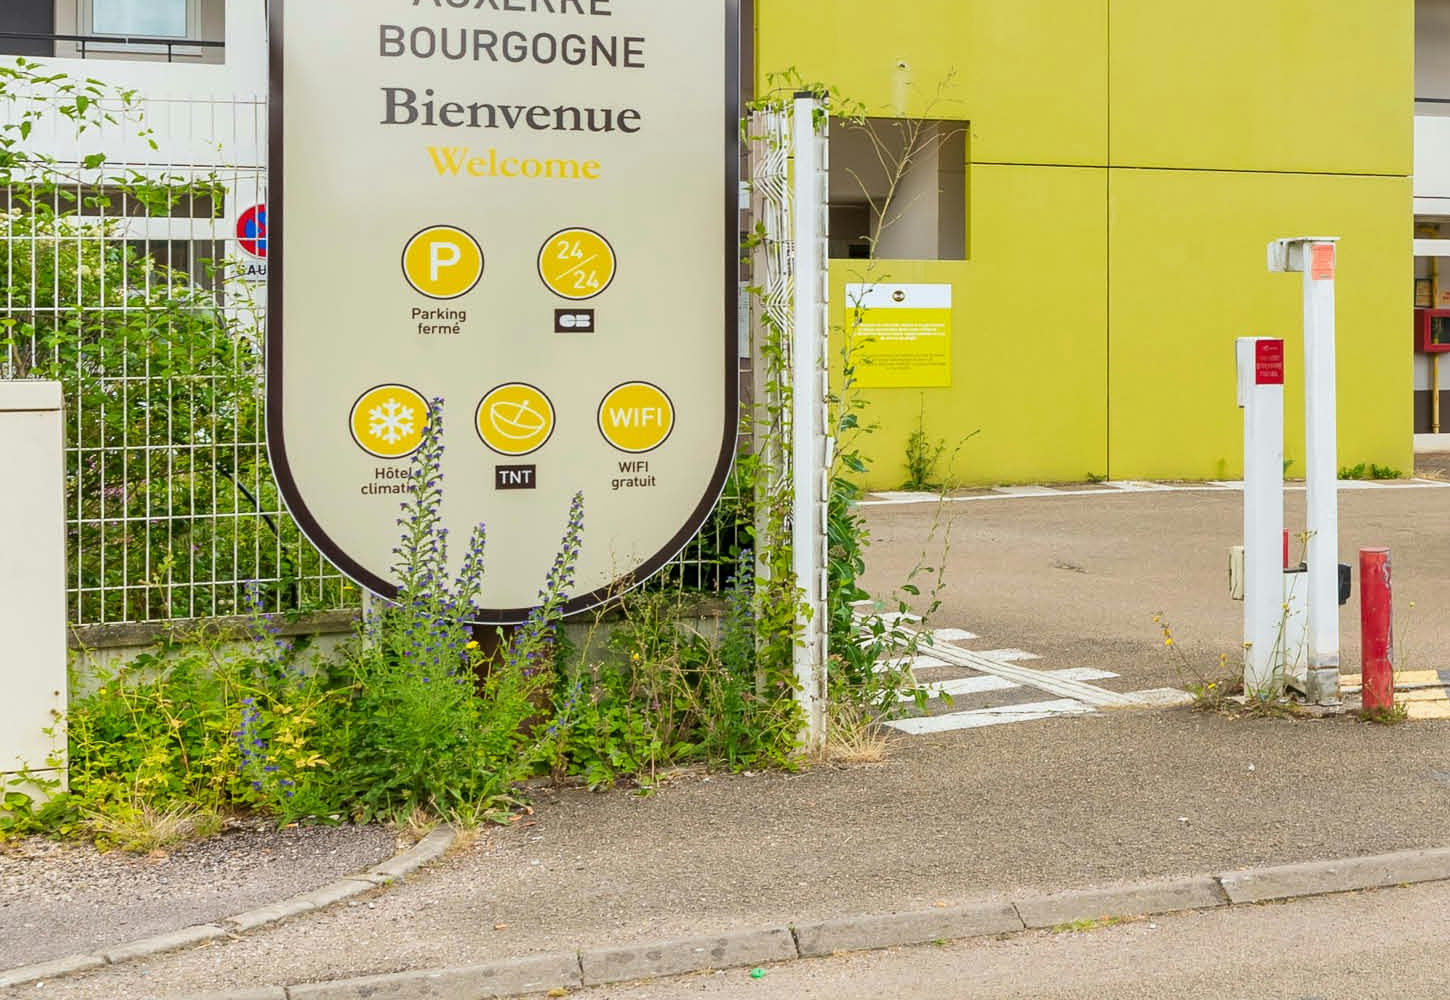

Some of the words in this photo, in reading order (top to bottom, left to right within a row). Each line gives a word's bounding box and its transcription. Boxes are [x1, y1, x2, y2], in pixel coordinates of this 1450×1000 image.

[379, 24, 646, 69] BOURGOGNE
[380, 87, 641, 133] Bienvenue
[427, 146, 601, 180] Welcome
[557, 240, 583, 259] 24
[430, 242, 461, 281] P
[573, 270, 599, 289] 24
[411, 308, 467, 322] Parking
[417, 322, 461, 335] fermé
[609, 408, 663, 427] WIFI
[375, 467, 413, 480] Hôtel
[618, 461, 649, 473] WIFI
[499, 470, 532, 484] TNT
[611, 475, 656, 489] gratuit
